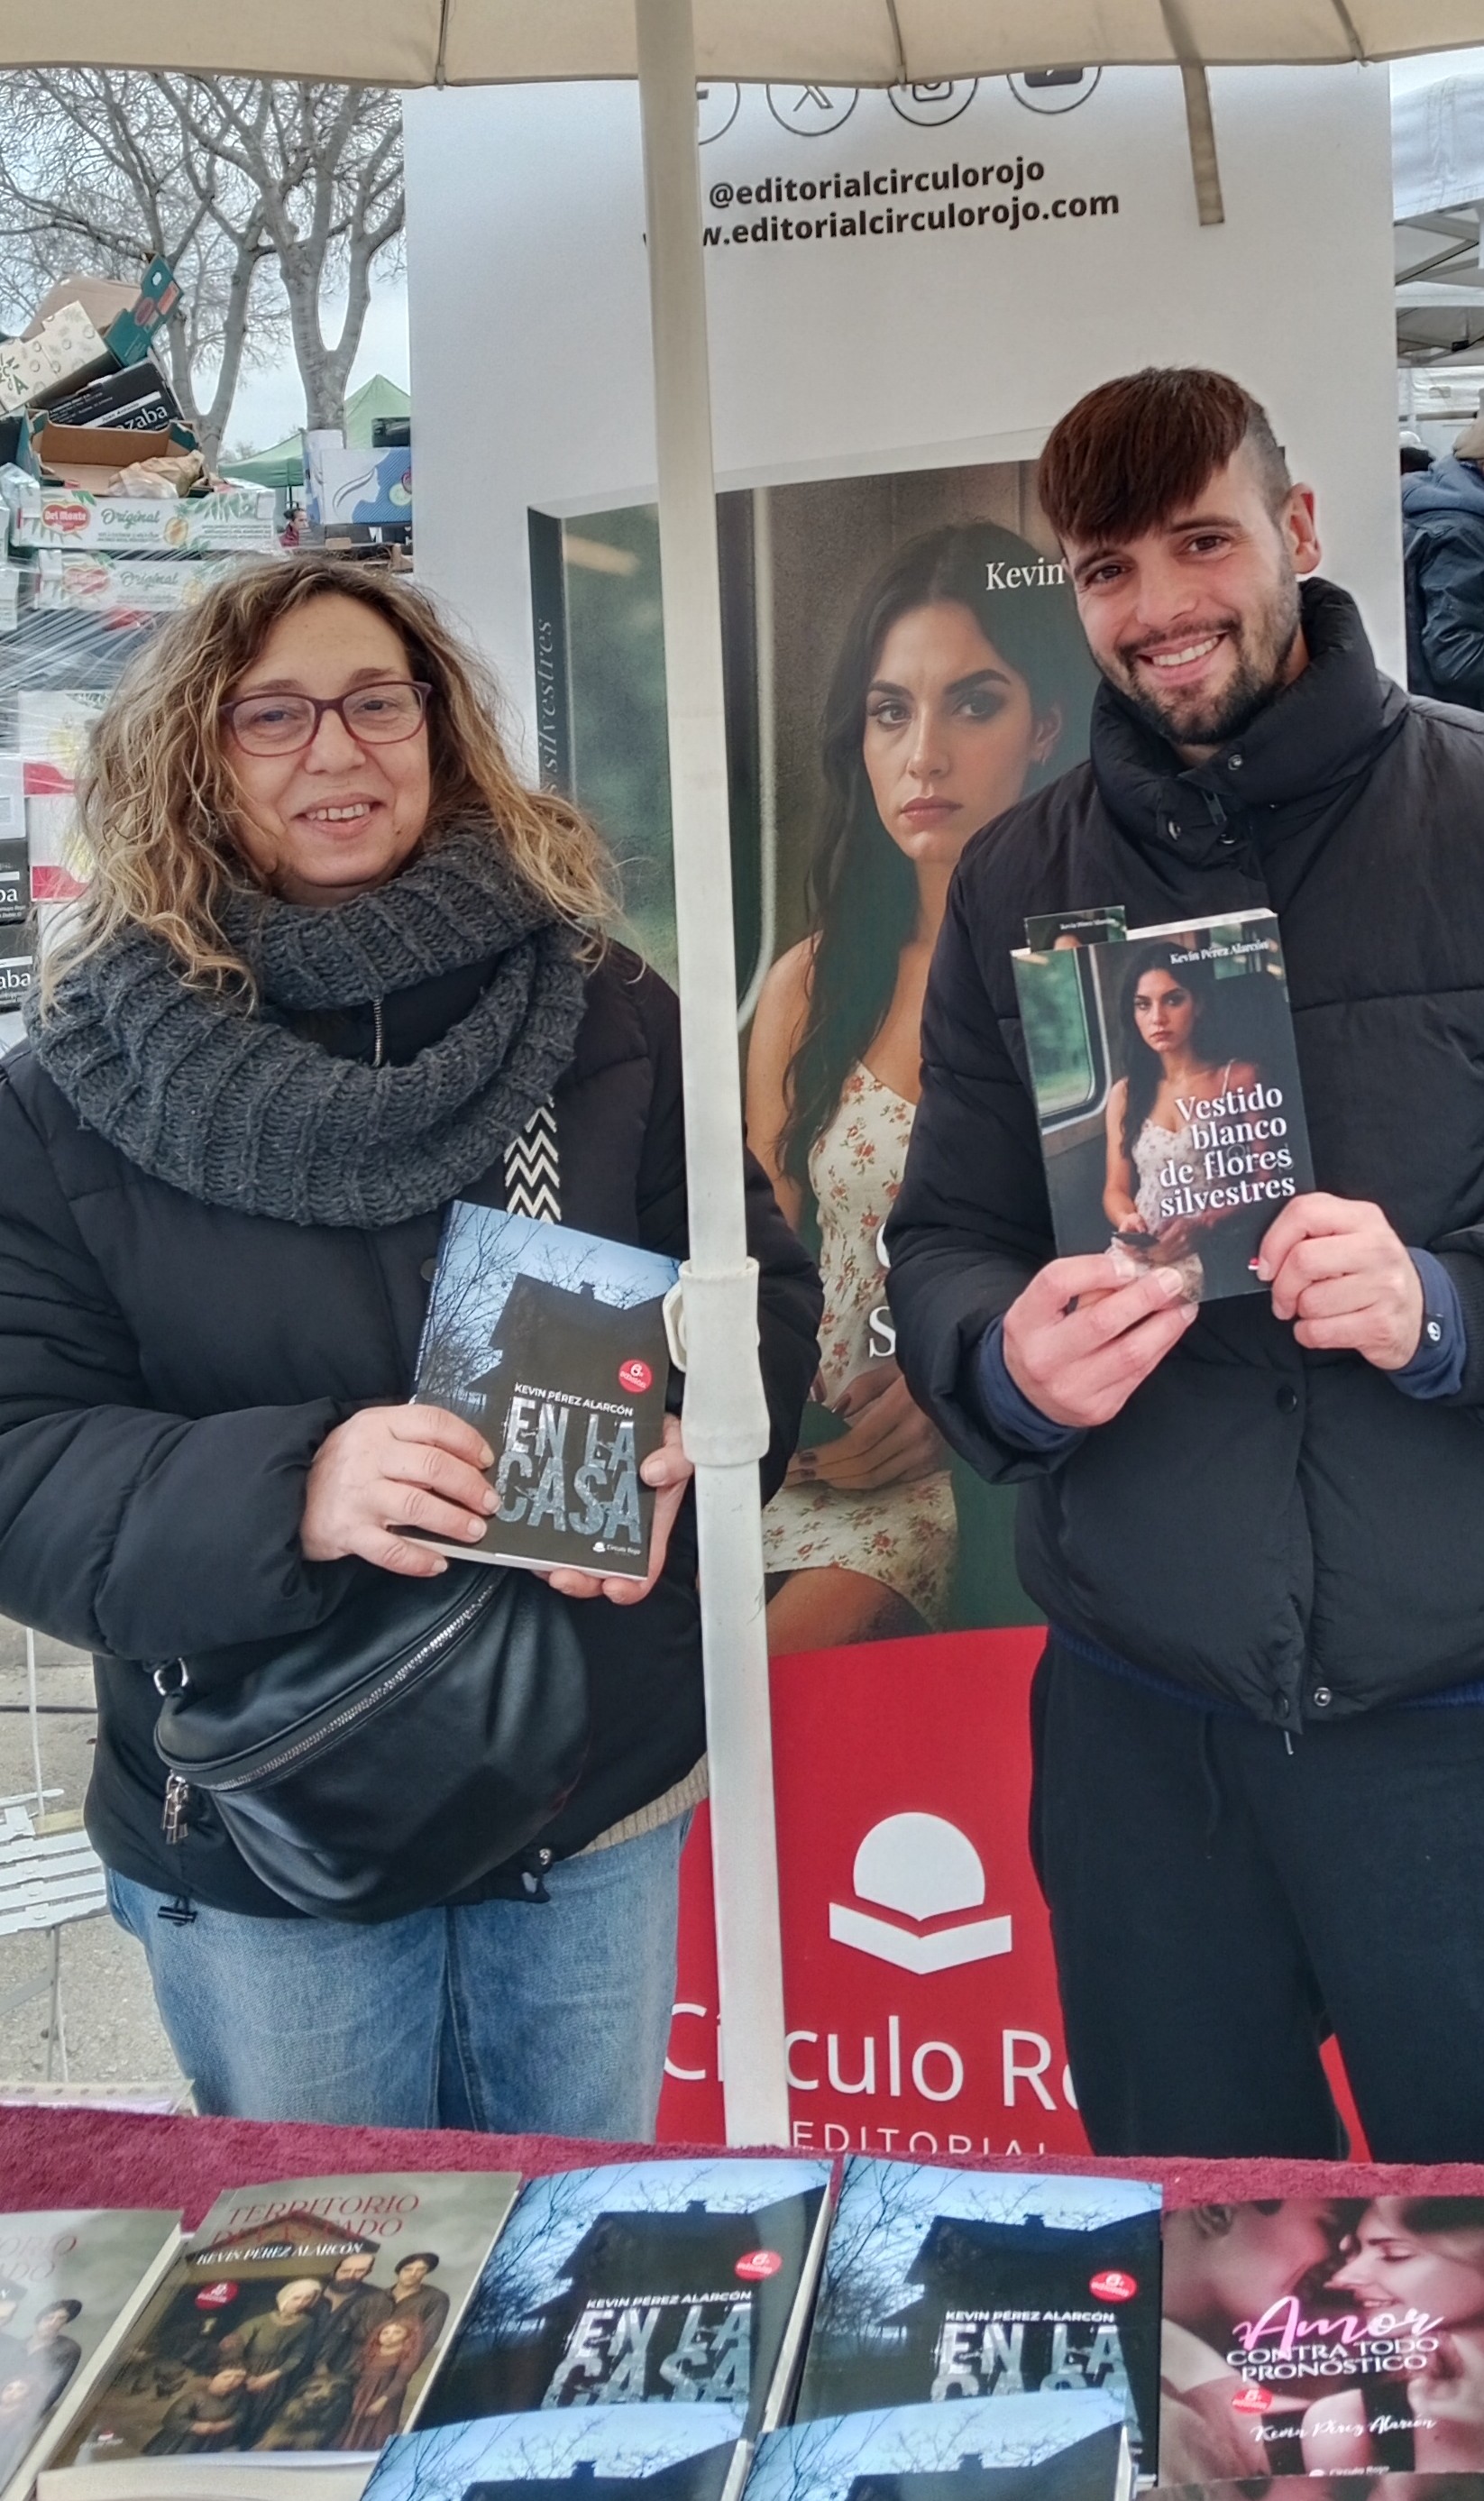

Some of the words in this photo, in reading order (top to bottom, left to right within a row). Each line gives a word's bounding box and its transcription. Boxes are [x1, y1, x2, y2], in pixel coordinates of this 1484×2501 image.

[710, 156, 1045, 209] @editorialcirculorojo
[45, 510, 60, 520] Del
[60, 510, 87, 521] Monte
[101, 508, 160, 530] Original
[120, 571, 179, 593] Original
[985, 558, 1065, 590] Kevin
[536, 618, 558, 774] silvestres
[1170, 951, 1200, 965] Kevin
[1175, 1083, 1283, 1122] Vestido
[1191, 1116, 1287, 1150] blanco
[1159, 1159, 1195, 1188] de
[1203, 1148, 1295, 1181] flores
[1160, 1177, 1296, 1218] silvestres
[514, 1382, 546, 1398] KEVIN
[547, 1390, 582, 1406] PÉREZ
[582, 1398, 634, 1417] ALARCÓN
[503, 1396, 570, 1457] EN
[584, 1414, 637, 1472] LA
[497, 1450, 642, 1544] CASA
[228, 2193, 420, 2225] TERRITORIO
[196, 2248, 241, 2266] KEVIN
[586, 2296, 630, 2310] KEVIN
[632, 2294, 680, 2308] PÉREZ
[680, 2289, 753, 2304] ALARCÓN
[946, 2310, 990, 2322] KEVIN
[992, 2309, 1041, 2322] PÉREZ
[1042, 2310, 1115, 2322] ALARCÓN
[566, 2306, 662, 2359] EN
[678, 2302, 752, 2351] LA
[1232, 2295, 1444, 2360] Amor
[936, 2322, 1025, 2375] EN
[1050, 2322, 1124, 2375] LA
[1226, 2342, 1349, 2366] CONTRA
[1352, 2336, 1440, 2357] TODO
[1241, 2354, 1427, 2382] PRONÓSTICO
[1250, 2423, 1306, 2442] Kevin
[1312, 2418, 1364, 2438] Pérez
[1367, 2413, 1437, 2434] Alarcón
